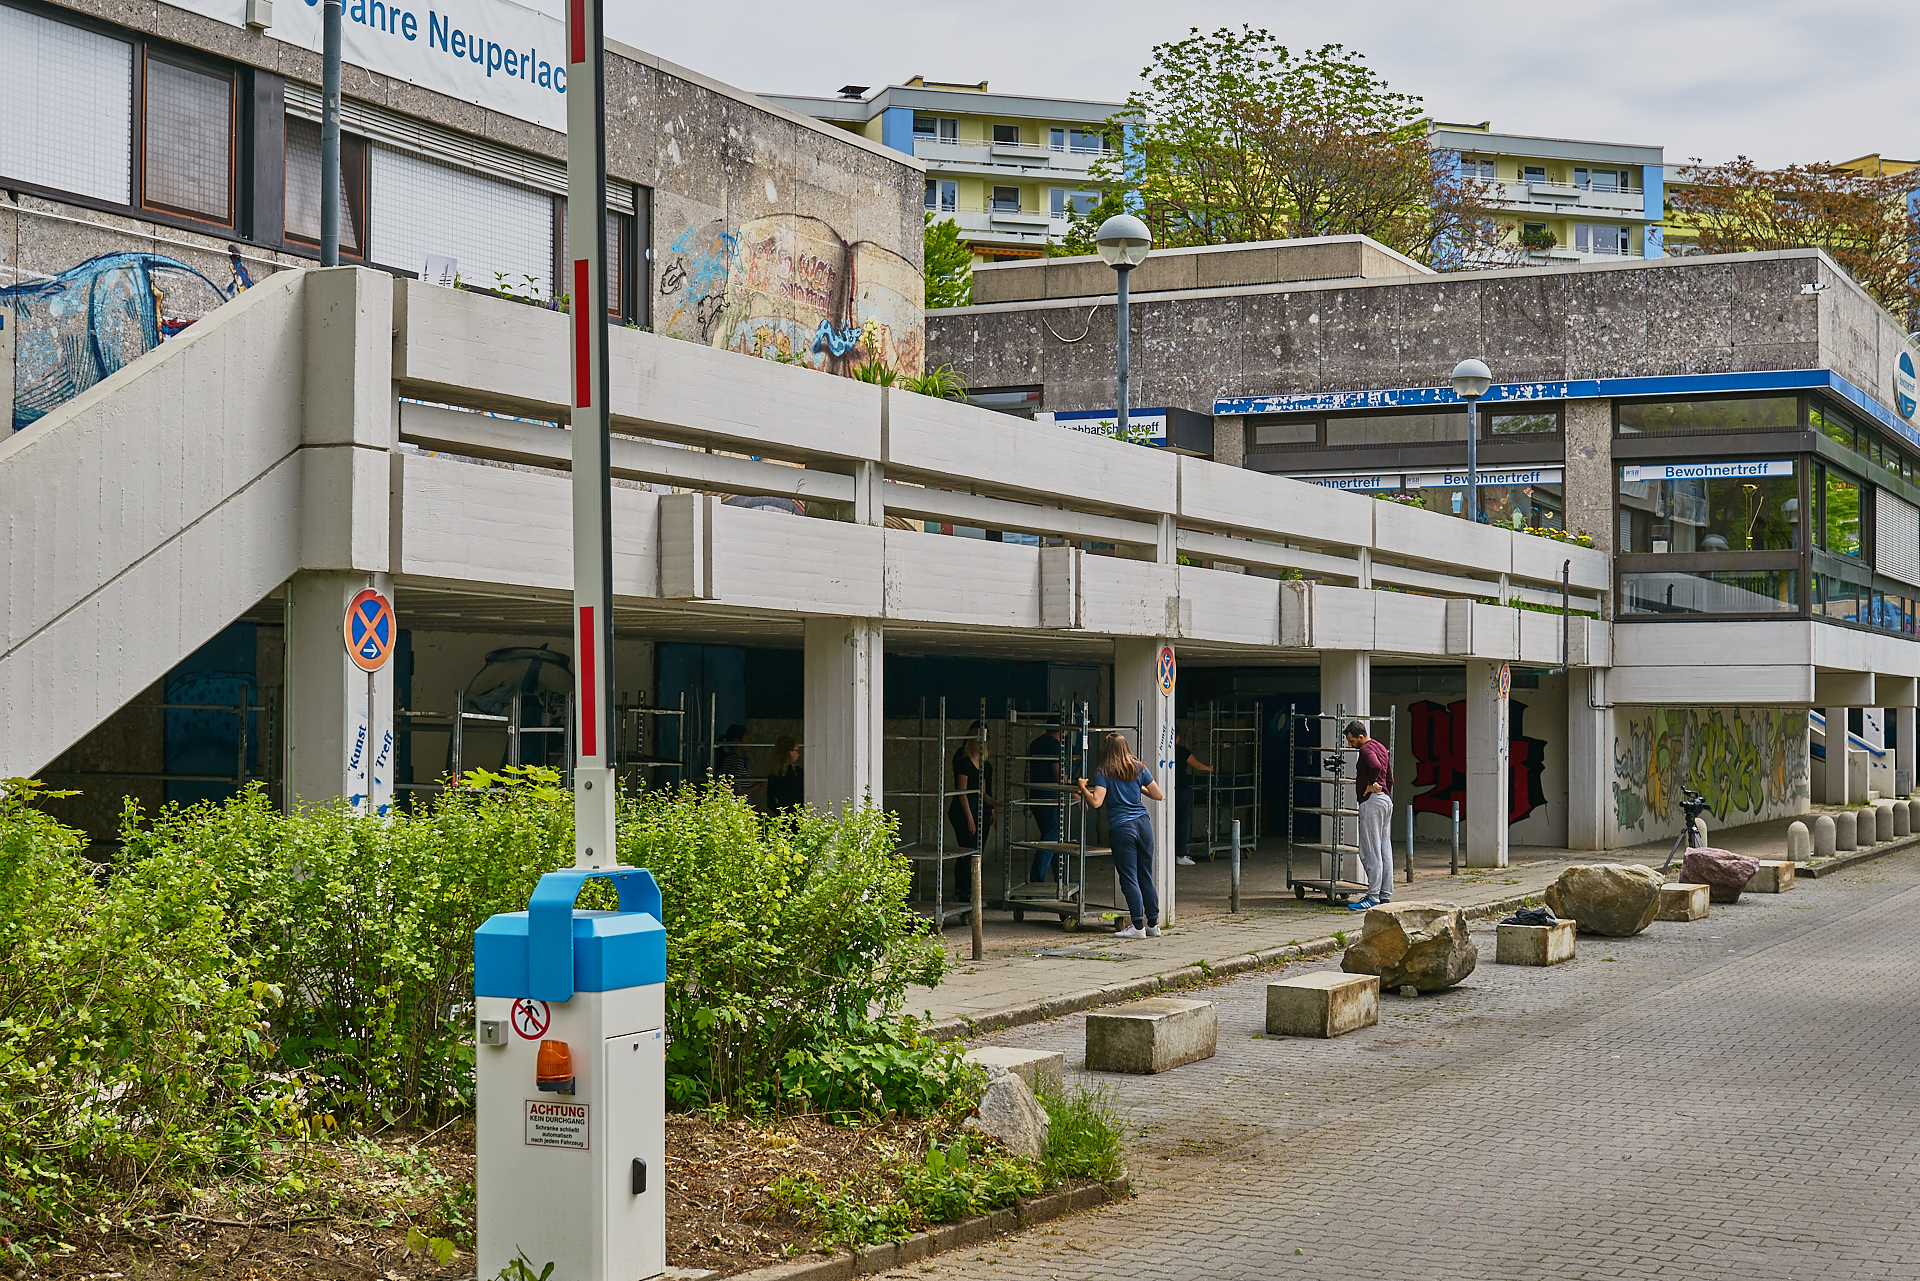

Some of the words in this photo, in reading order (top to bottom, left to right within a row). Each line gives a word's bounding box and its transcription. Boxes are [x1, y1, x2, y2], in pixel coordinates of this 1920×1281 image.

[342, 0, 417, 42] ahre
[1665, 463, 1769, 477] Bewohnertreff
[375, 729, 393, 768] Treff
[530, 1104, 585, 1118] ACHTUNG
[545, 1116, 585, 1125] DURCHGANG
[535, 1124, 558, 1132] Schranke
[542, 1131, 573, 1139] automatisch
[544, 1137, 560, 1145] jedem
[561, 1139, 584, 1147] Fahrzeug
